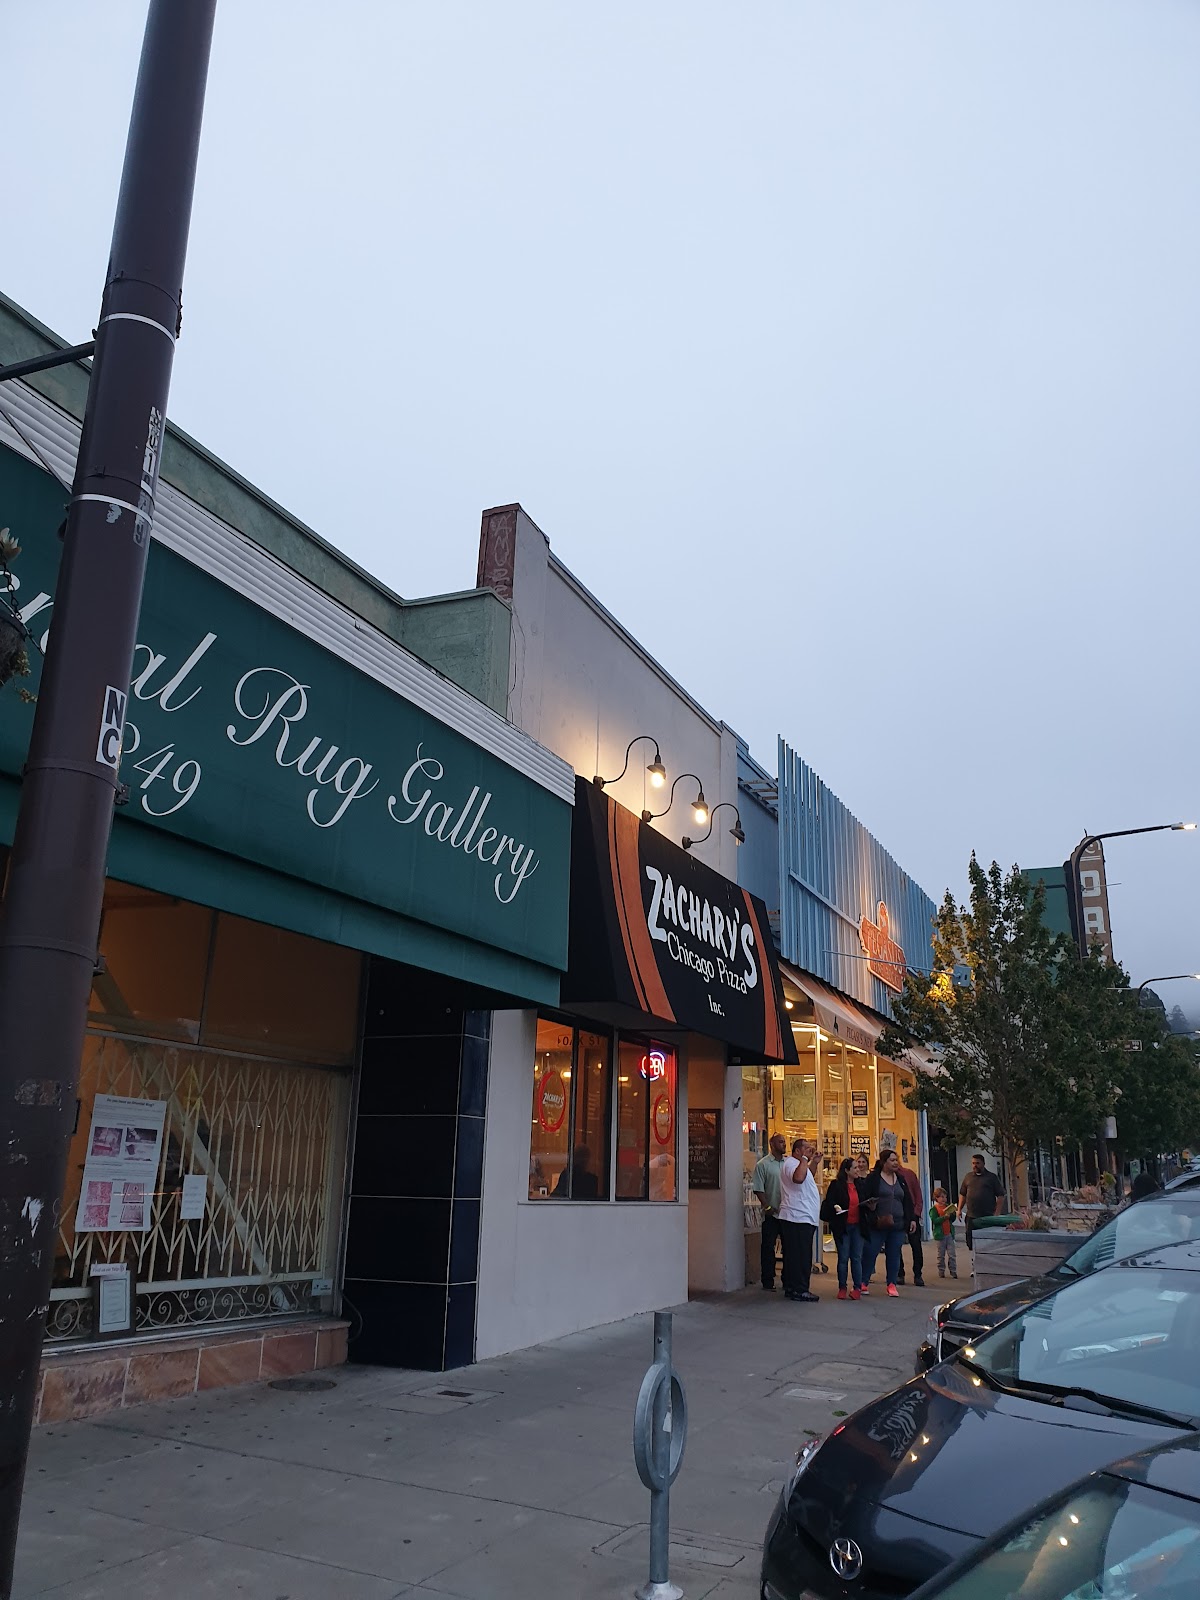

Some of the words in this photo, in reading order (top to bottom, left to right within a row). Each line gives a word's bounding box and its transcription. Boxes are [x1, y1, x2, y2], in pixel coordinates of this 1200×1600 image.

[226, 667, 380, 828] Rug
[388, 742, 540, 904] Gallery
[645, 865, 758, 989] ZACHARY'S
[867, 931, 904, 975] PEGASUS
[667, 931, 715, 983] Chicago
[716, 956, 748, 995] Pizza
[708, 994, 726, 1017] Inc.
[846, 1026, 864, 1045] PEGASUS
